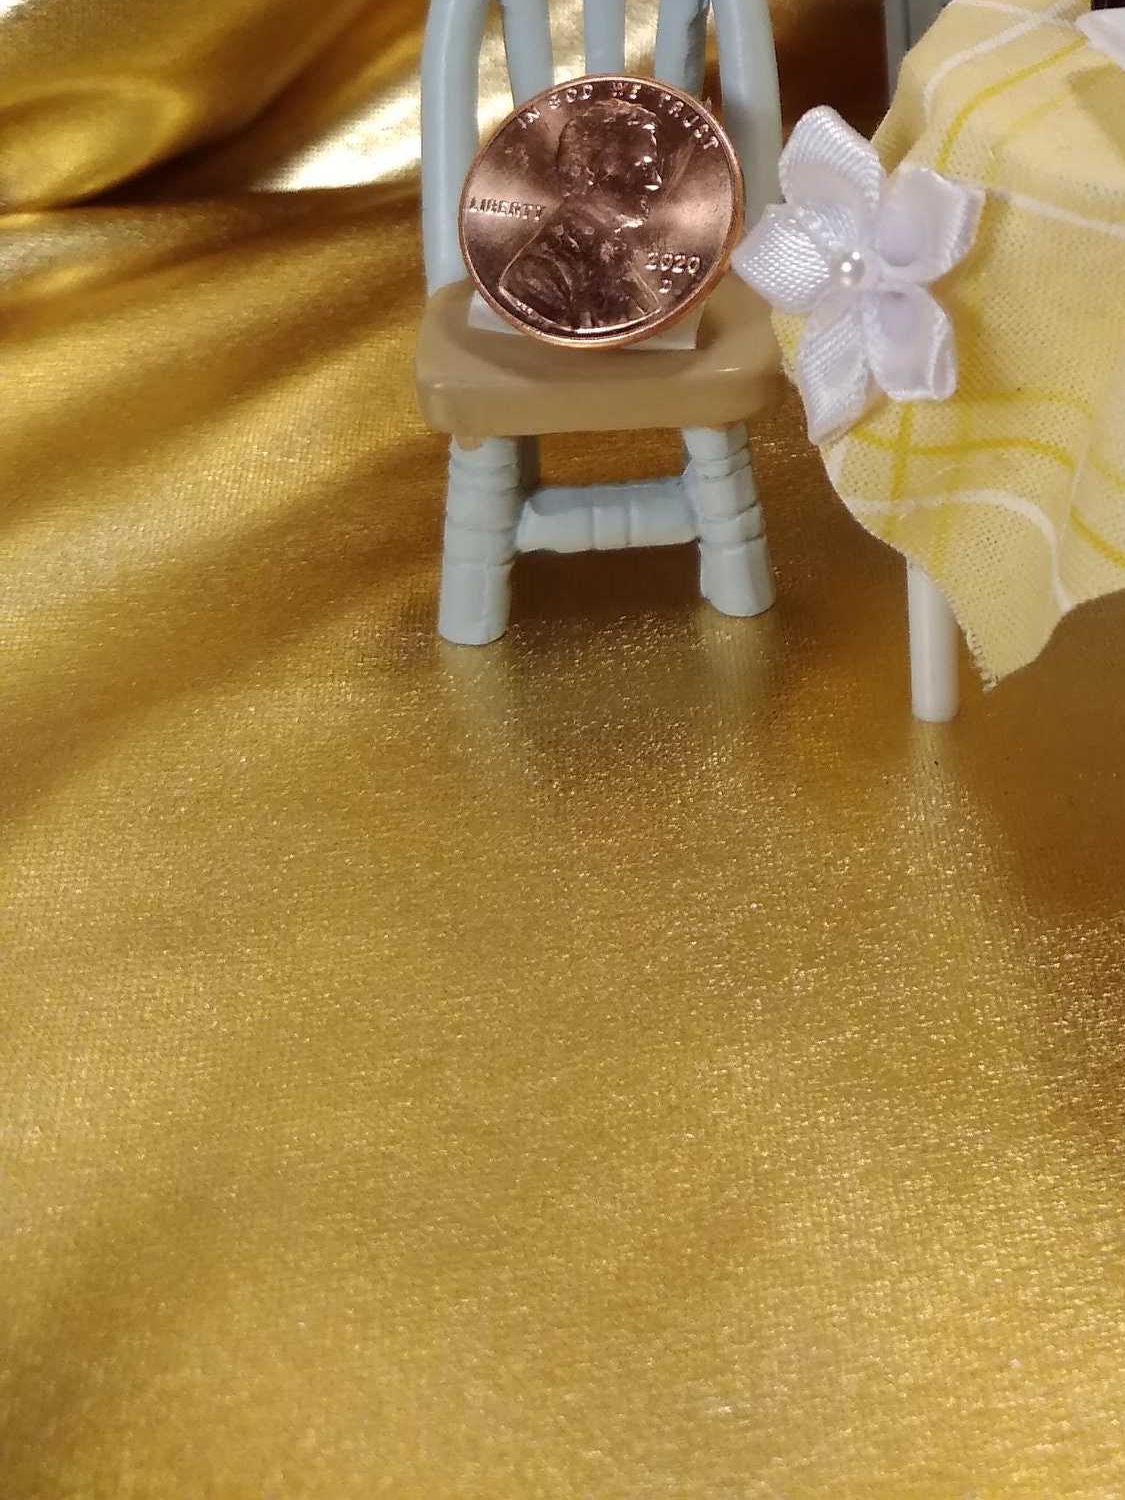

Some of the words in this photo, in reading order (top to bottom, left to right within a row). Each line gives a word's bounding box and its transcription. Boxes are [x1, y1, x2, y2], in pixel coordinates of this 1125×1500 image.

[517, 105, 541, 130] IN
[549, 82, 594, 110] GOD
[612, 81, 642, 100] WE
[658, 91, 720, 150] TRUST
[468, 196, 546, 221] LIBERTY
[645, 252, 700, 274] 2020
